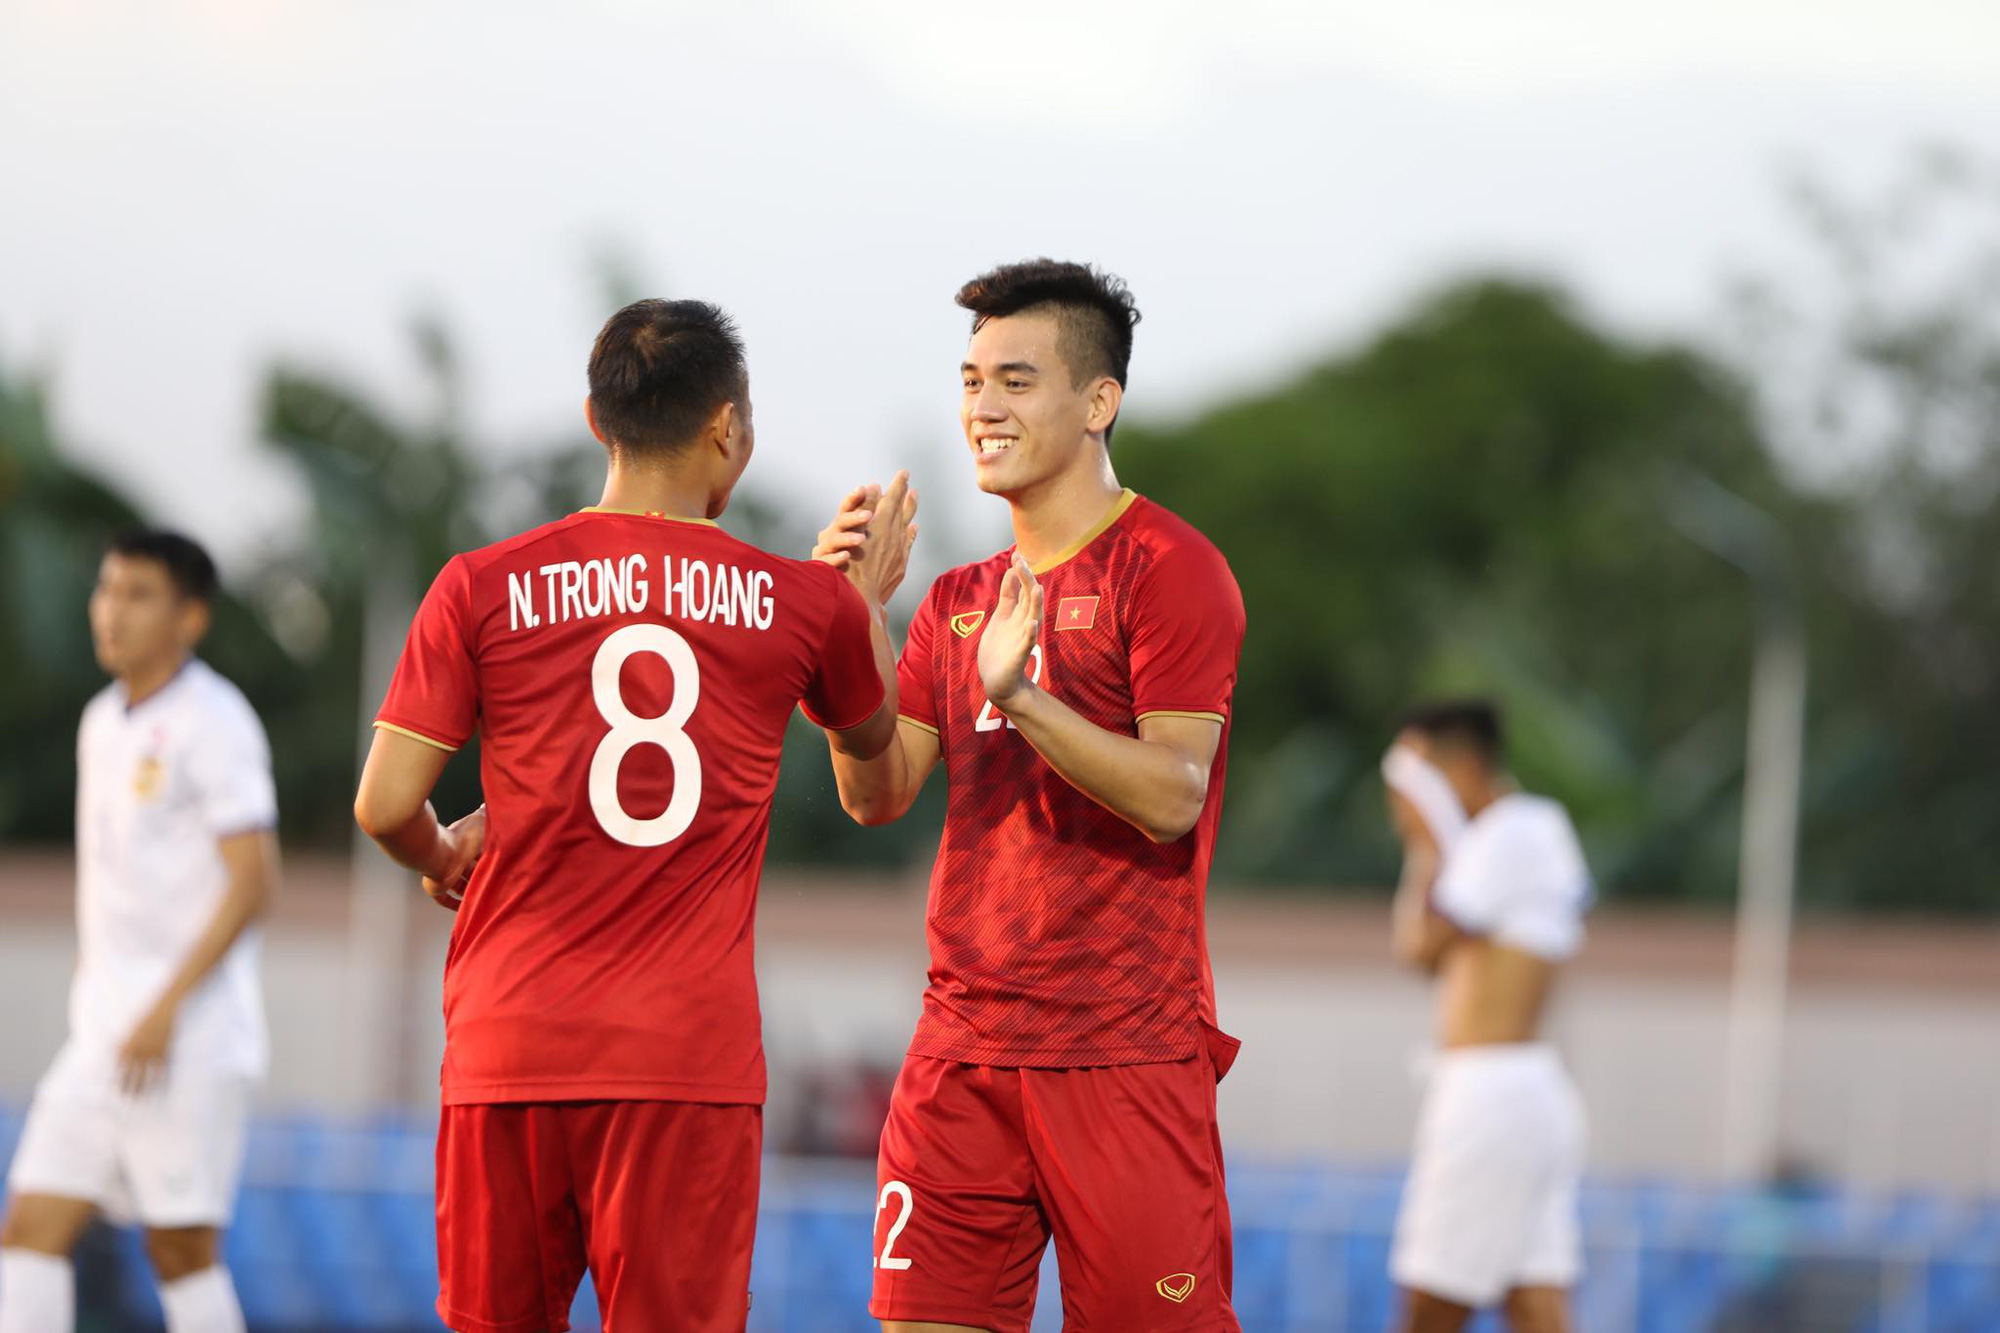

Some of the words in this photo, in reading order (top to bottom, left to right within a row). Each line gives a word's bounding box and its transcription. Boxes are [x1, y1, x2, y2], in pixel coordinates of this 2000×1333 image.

[664, 555, 774, 630] HOANG
[588, 623, 702, 847] 8
[873, 1180, 913, 1270] 2
